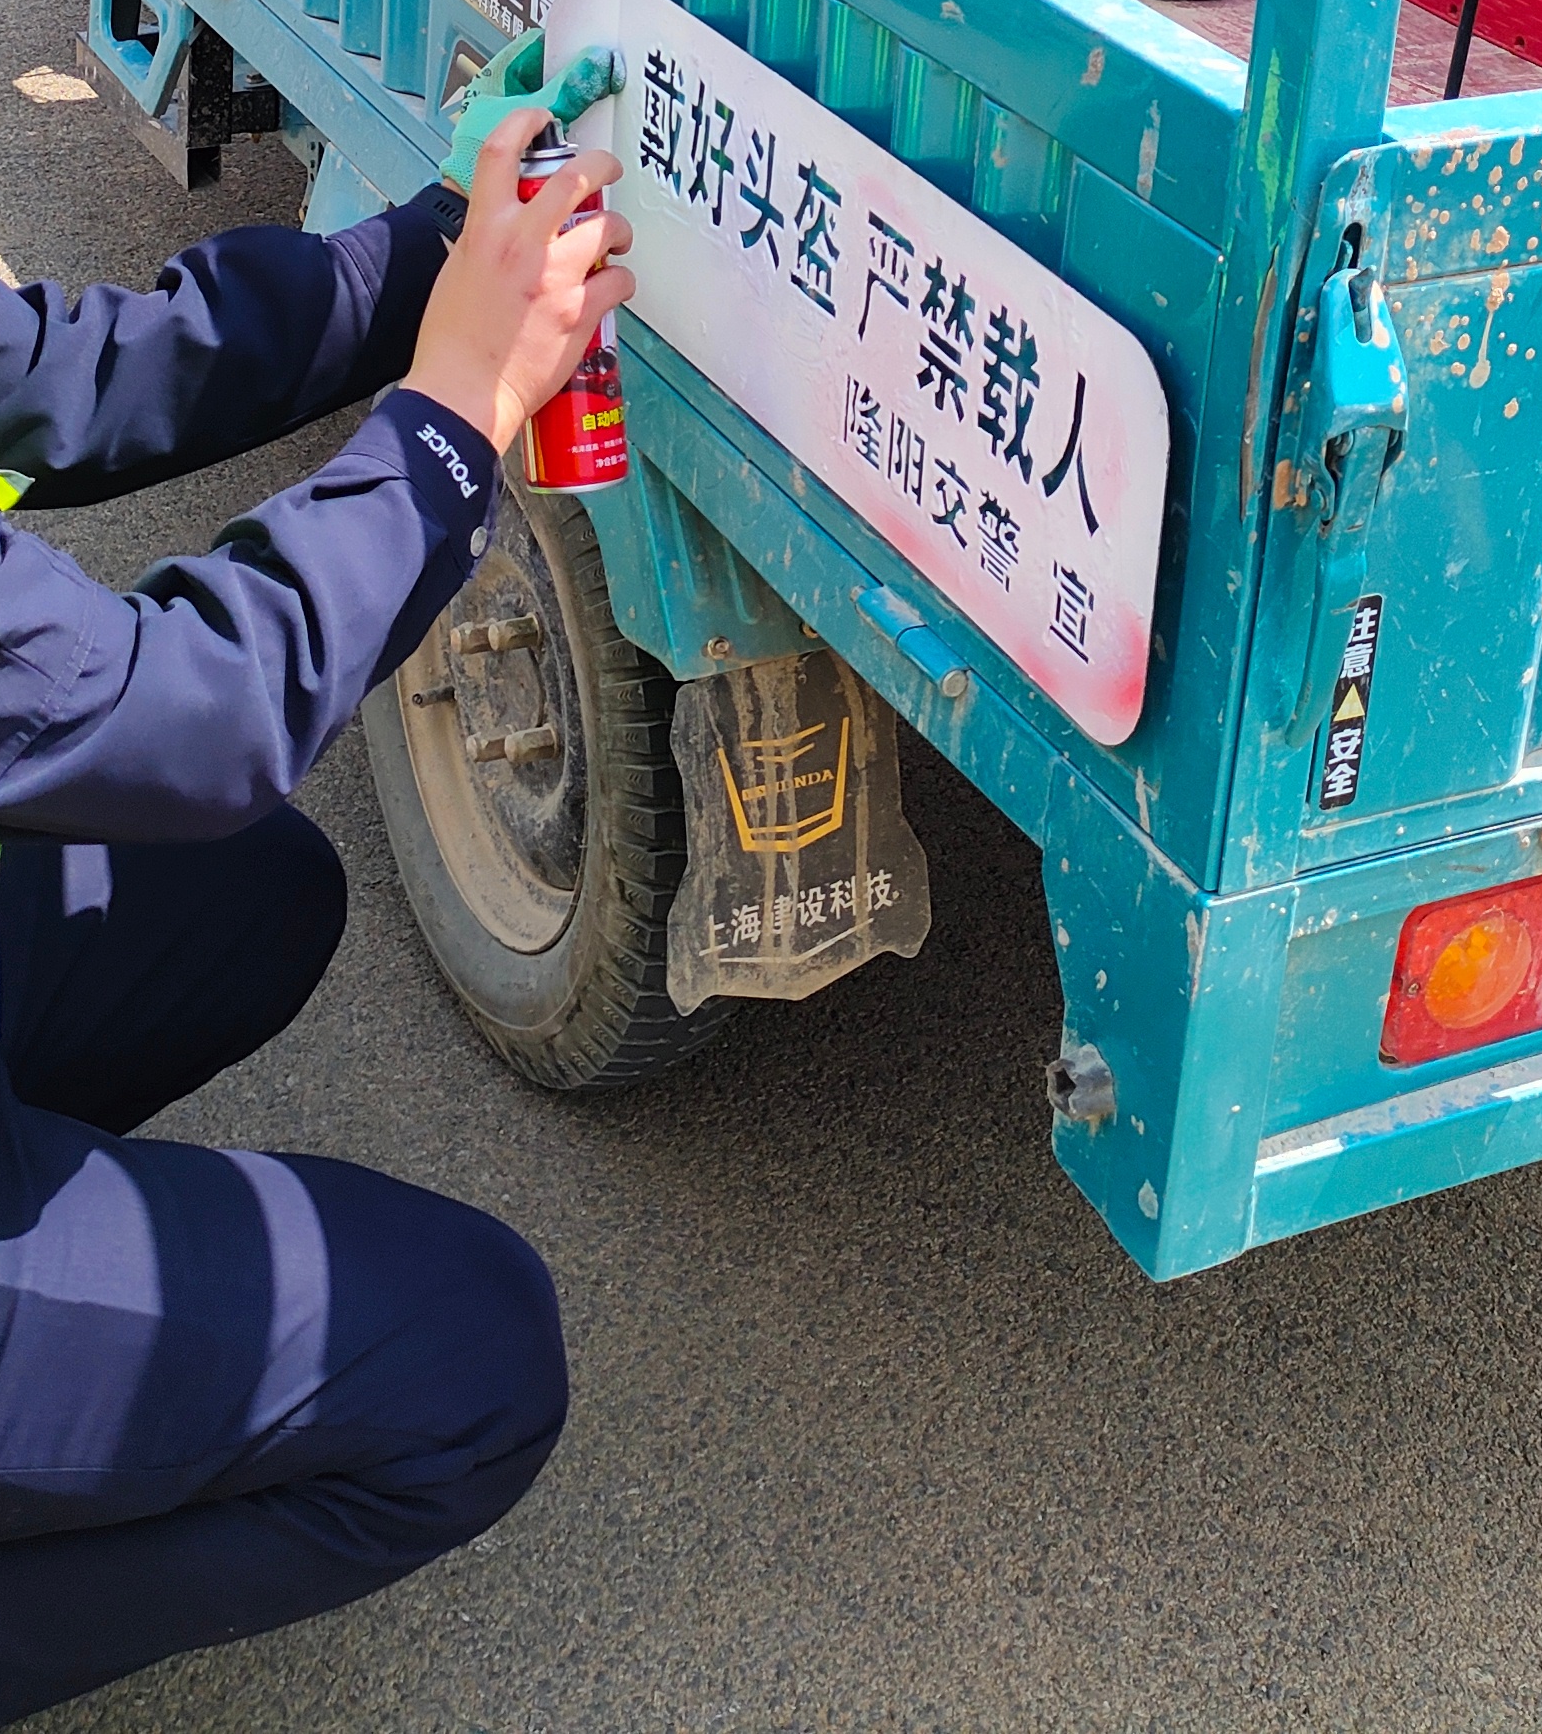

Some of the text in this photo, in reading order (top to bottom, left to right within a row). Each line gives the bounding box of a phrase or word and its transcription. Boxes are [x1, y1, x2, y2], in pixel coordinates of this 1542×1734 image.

[639, 48, 1100, 536] 戴好头盔 严禁载人
[415, 423, 480, 500] POLICE
[844, 373, 1095, 664] 隆阳交警 宣
[1323, 727, 1362, 800] 安全
[698, 868, 894, 957] 上海建设科技
